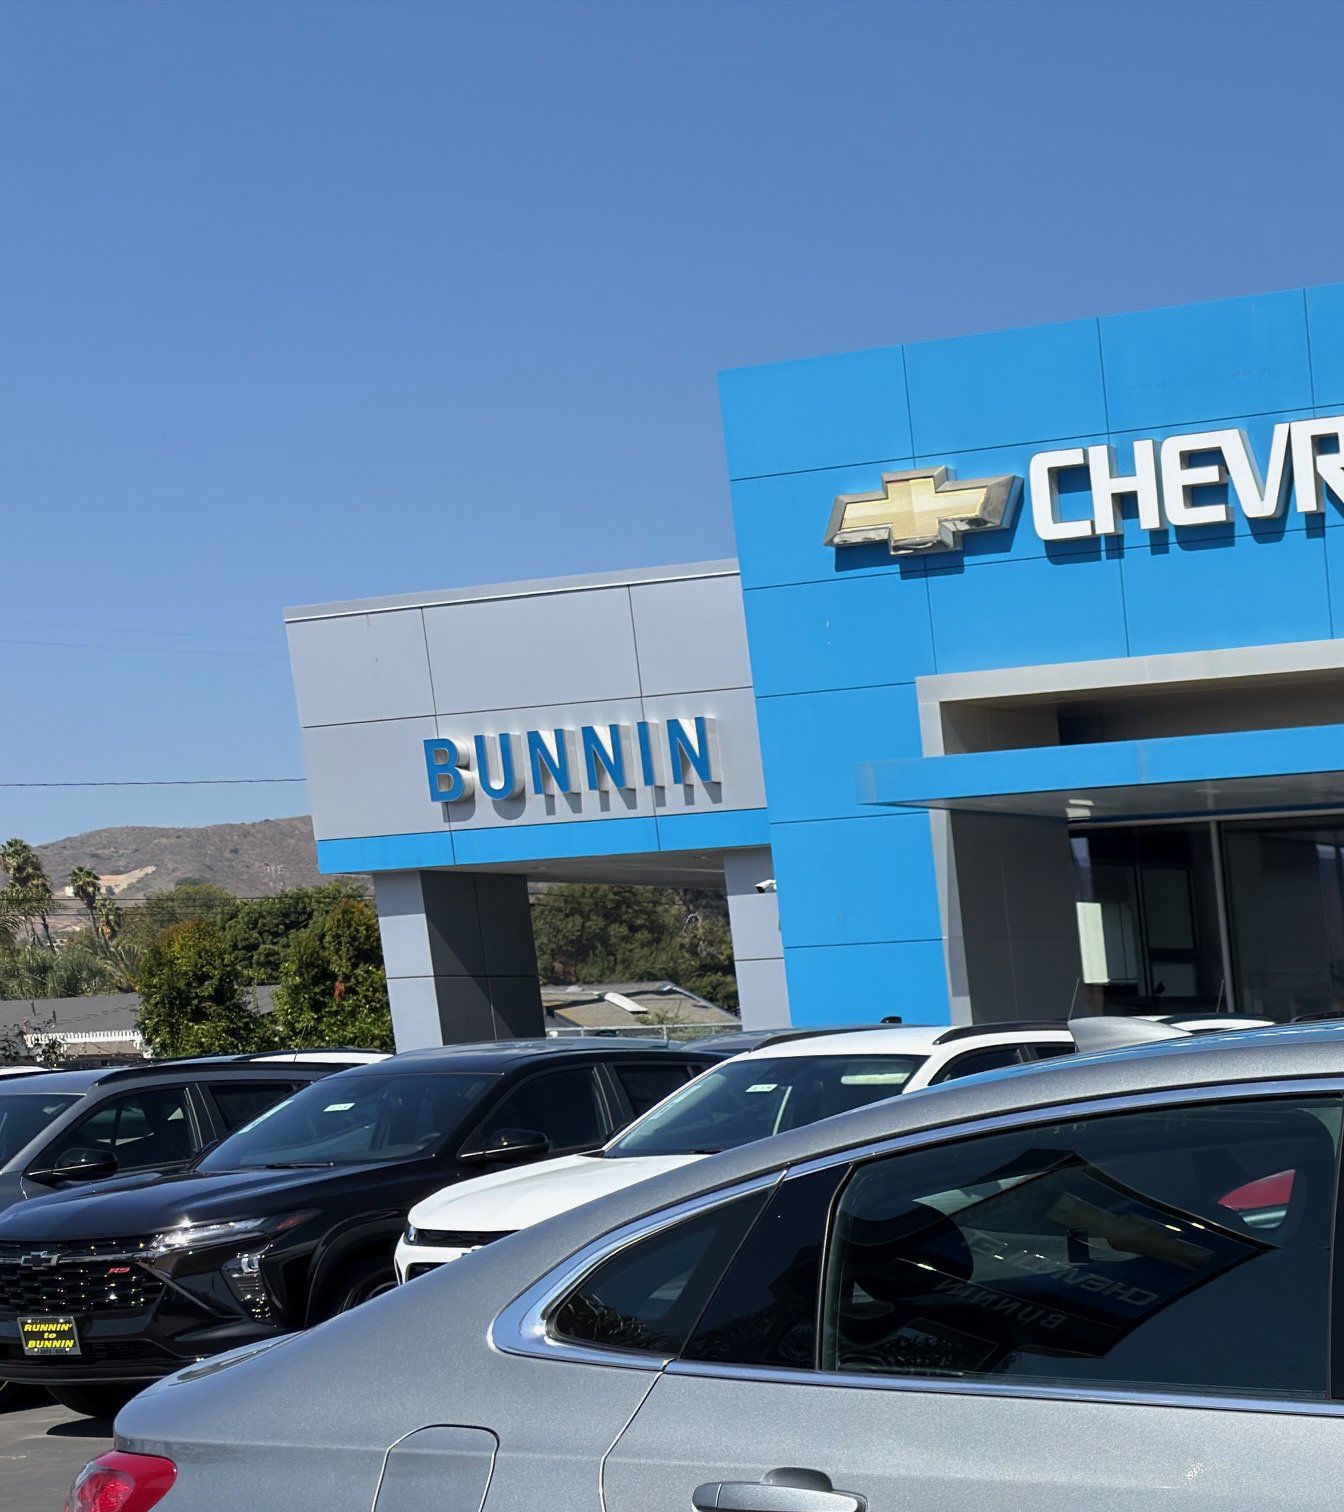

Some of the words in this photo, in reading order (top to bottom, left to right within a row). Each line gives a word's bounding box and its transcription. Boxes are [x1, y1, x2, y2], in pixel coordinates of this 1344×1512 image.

[423, 716, 718, 803] BUNNIN
[24, 1323, 73, 1331] RUNNIN'
[27, 1339, 75, 1348] BUNNIN
